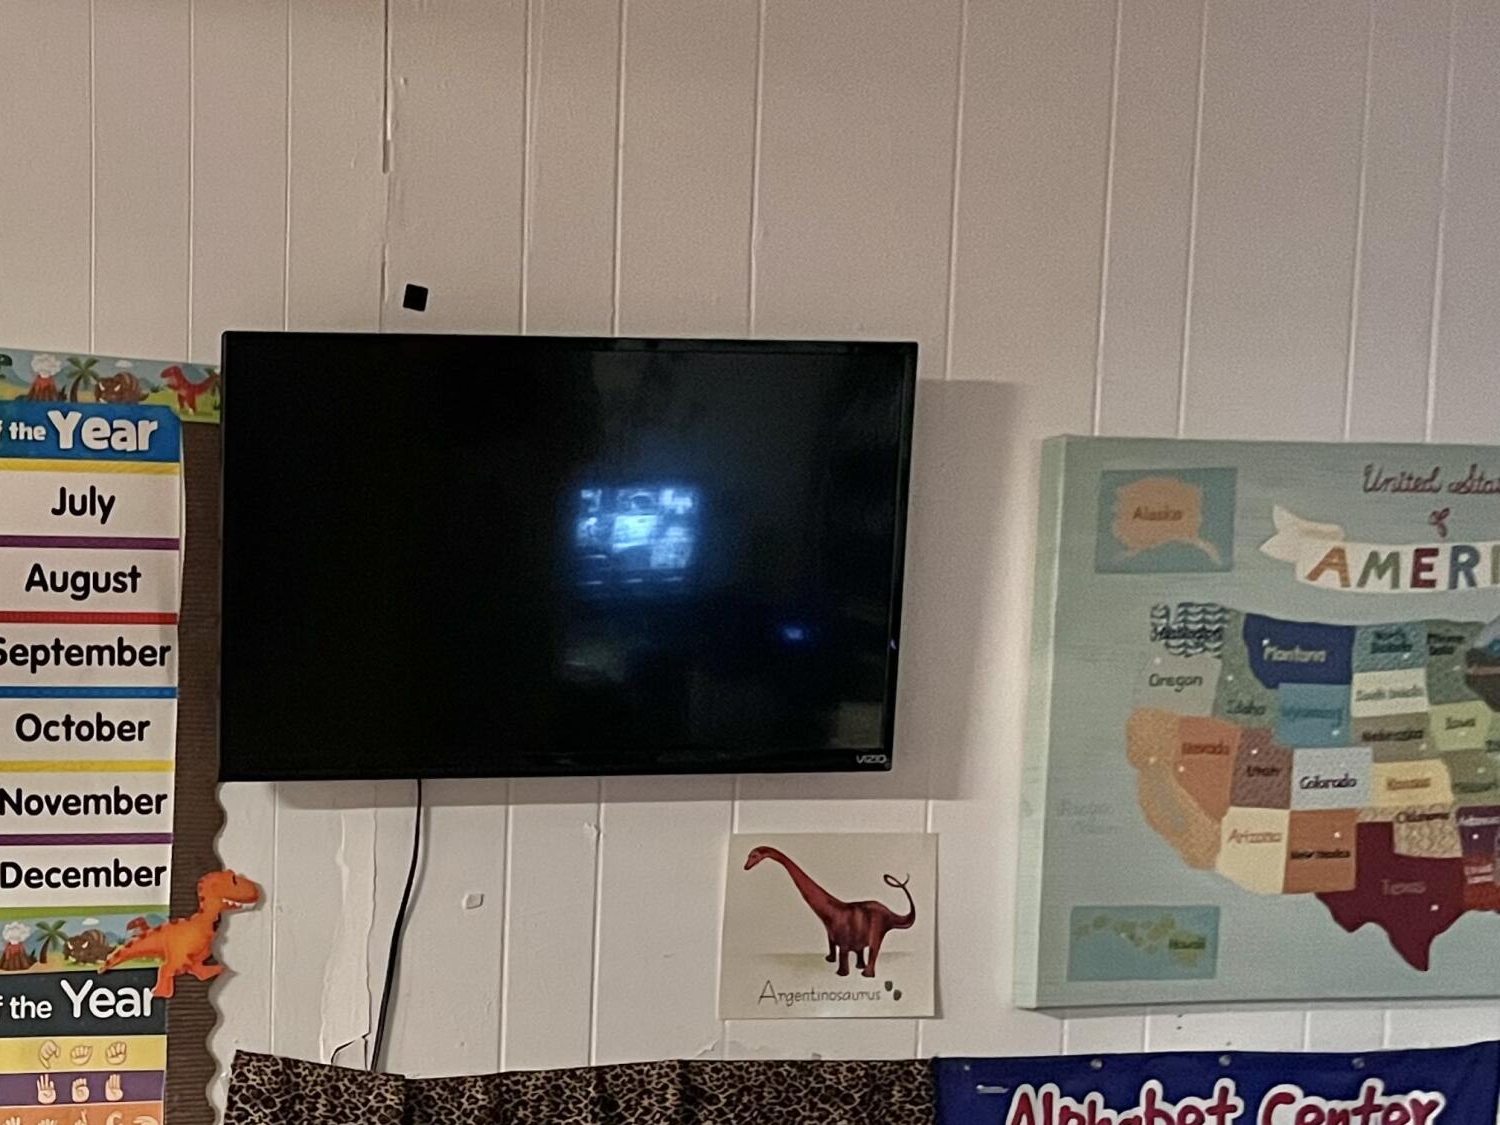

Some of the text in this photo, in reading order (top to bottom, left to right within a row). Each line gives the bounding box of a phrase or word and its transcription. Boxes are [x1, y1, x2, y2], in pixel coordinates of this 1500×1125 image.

[8, 420, 46, 441] the
[47, 410, 158, 452] Year
[1363, 462, 1442, 492] United
[51, 486, 116, 524] July
[25, 563, 141, 600] August
[1149, 673, 1202, 692] Oregon
[15, 713, 150, 743] October
[856, 755, 886, 763] VIZIO
[1300, 774, 1357, 789] Colorado
[0, 860, 166, 889] December
[10, 995, 51, 1019] the
[60, 979, 153, 1017] Year
[758, 980, 881, 1006] Argentinosaurus
